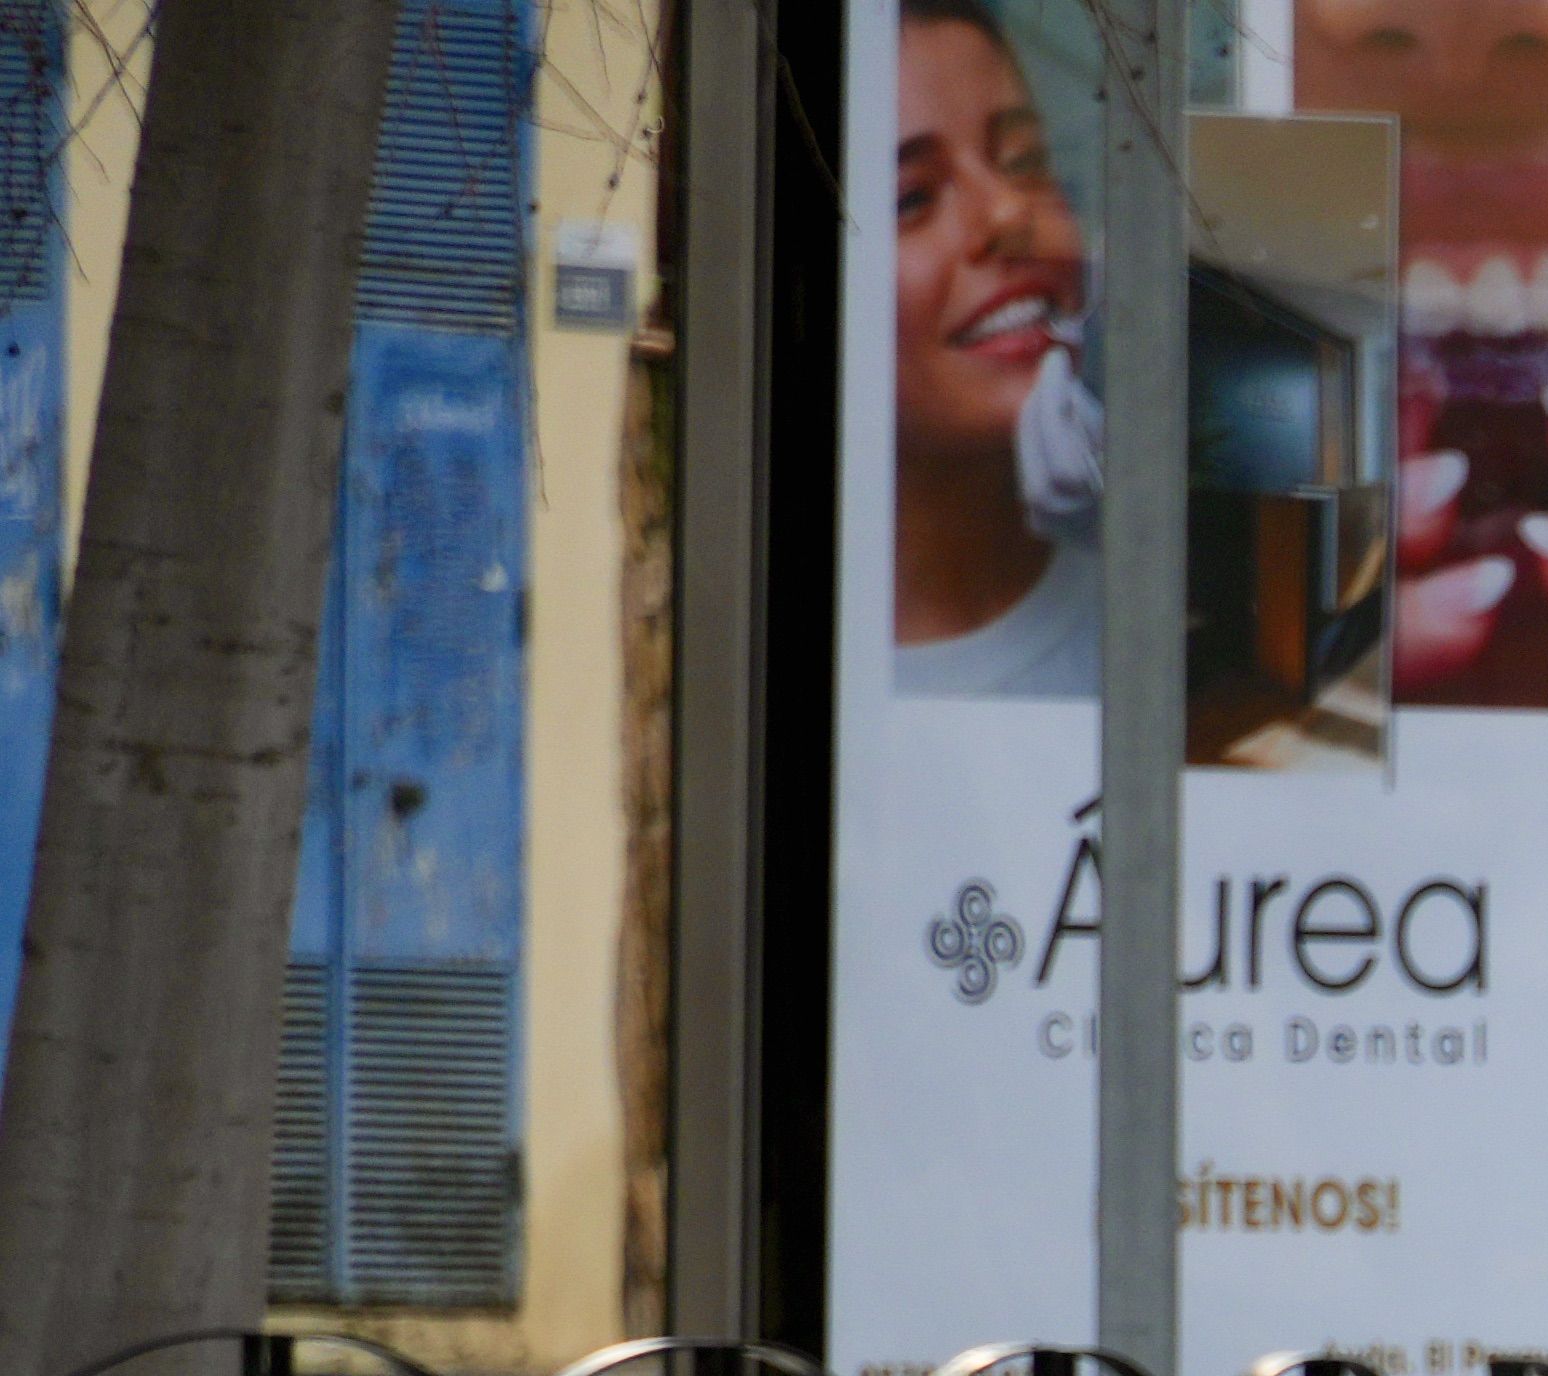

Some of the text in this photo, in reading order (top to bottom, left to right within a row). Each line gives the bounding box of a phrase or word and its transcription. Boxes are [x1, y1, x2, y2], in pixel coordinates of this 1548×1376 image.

[1037, 1010, 1489, 1064] Clca Dental
[1176, 1157, 1400, 1230] SÍTENOS!
